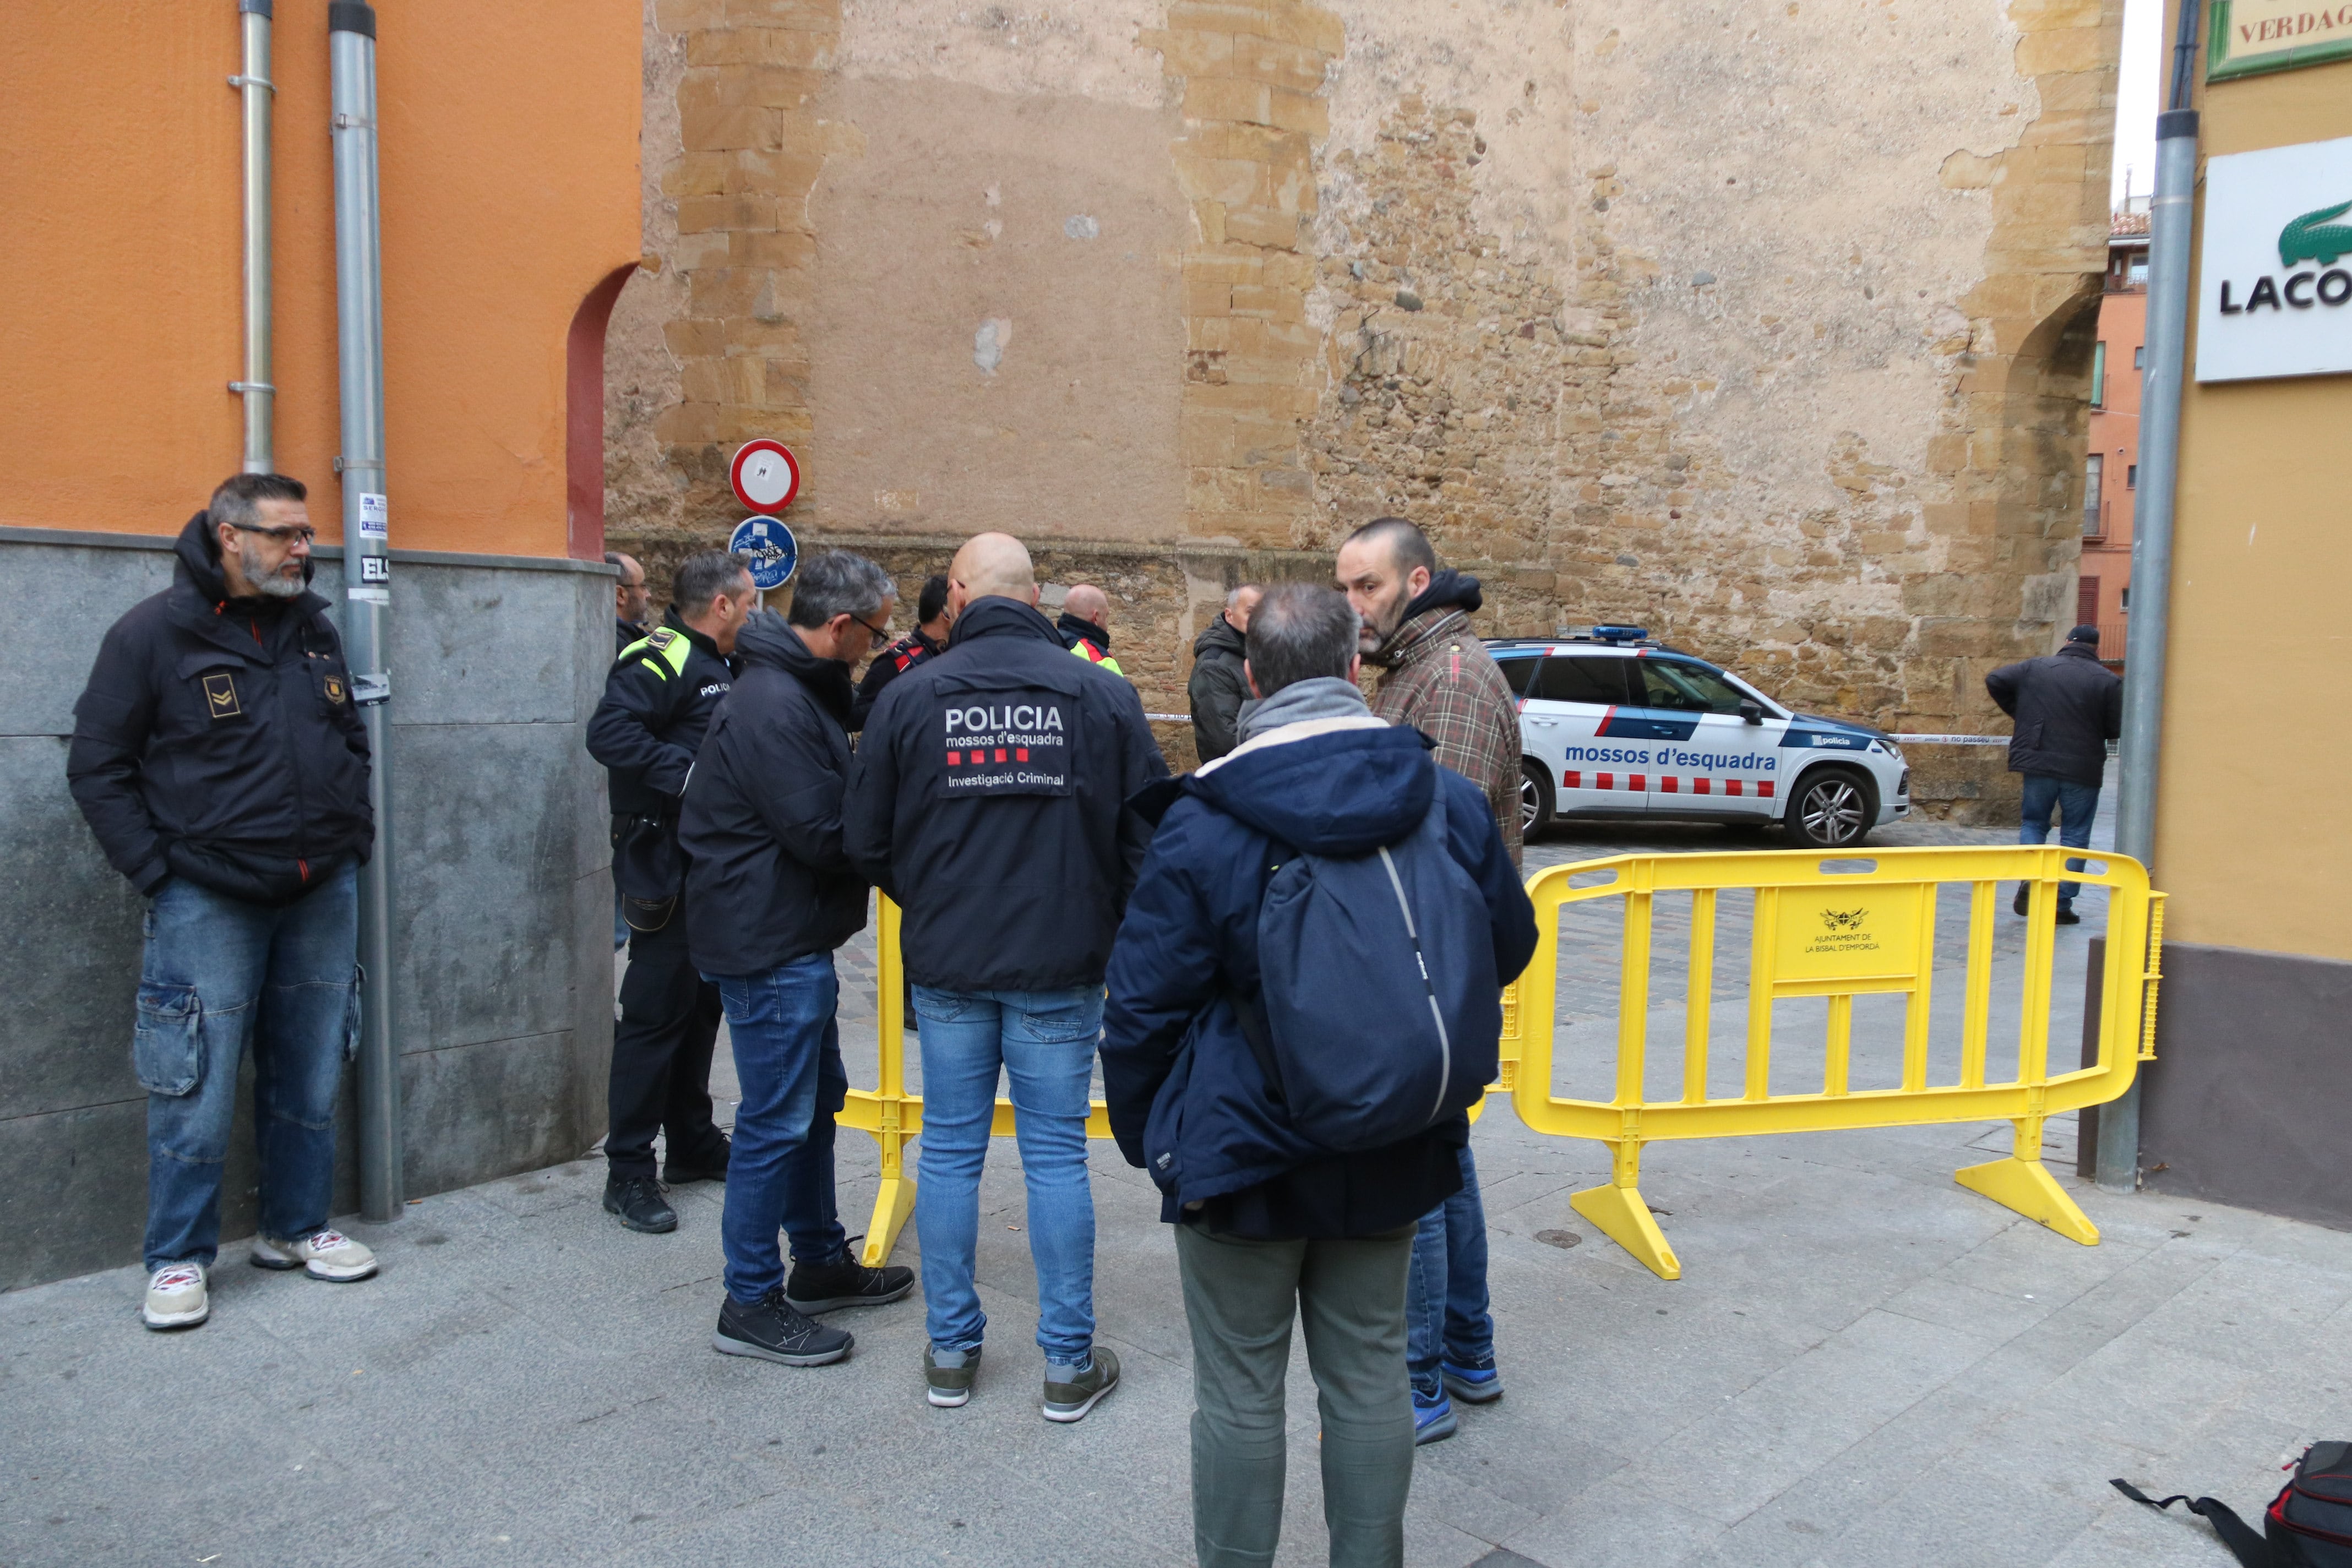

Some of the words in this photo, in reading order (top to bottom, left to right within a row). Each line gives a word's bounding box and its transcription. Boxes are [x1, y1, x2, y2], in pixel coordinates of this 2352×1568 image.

[2220, 269, 2352, 313] LACO
[700, 683, 730, 696] POLICI
[946, 705, 1064, 733] POLICIA
[946, 734, 994, 748] mossos
[997, 731, 1063, 747] d'esquadra
[1822, 737, 1850, 745] policia
[1565, 747, 1649, 764] mossos
[1657, 748, 1776, 771] d'esquadra
[948, 772, 1014, 787] Investigació
[1017, 771, 1064, 786] Criminal
[1815, 934, 1860, 943] AJUNTAMENT
